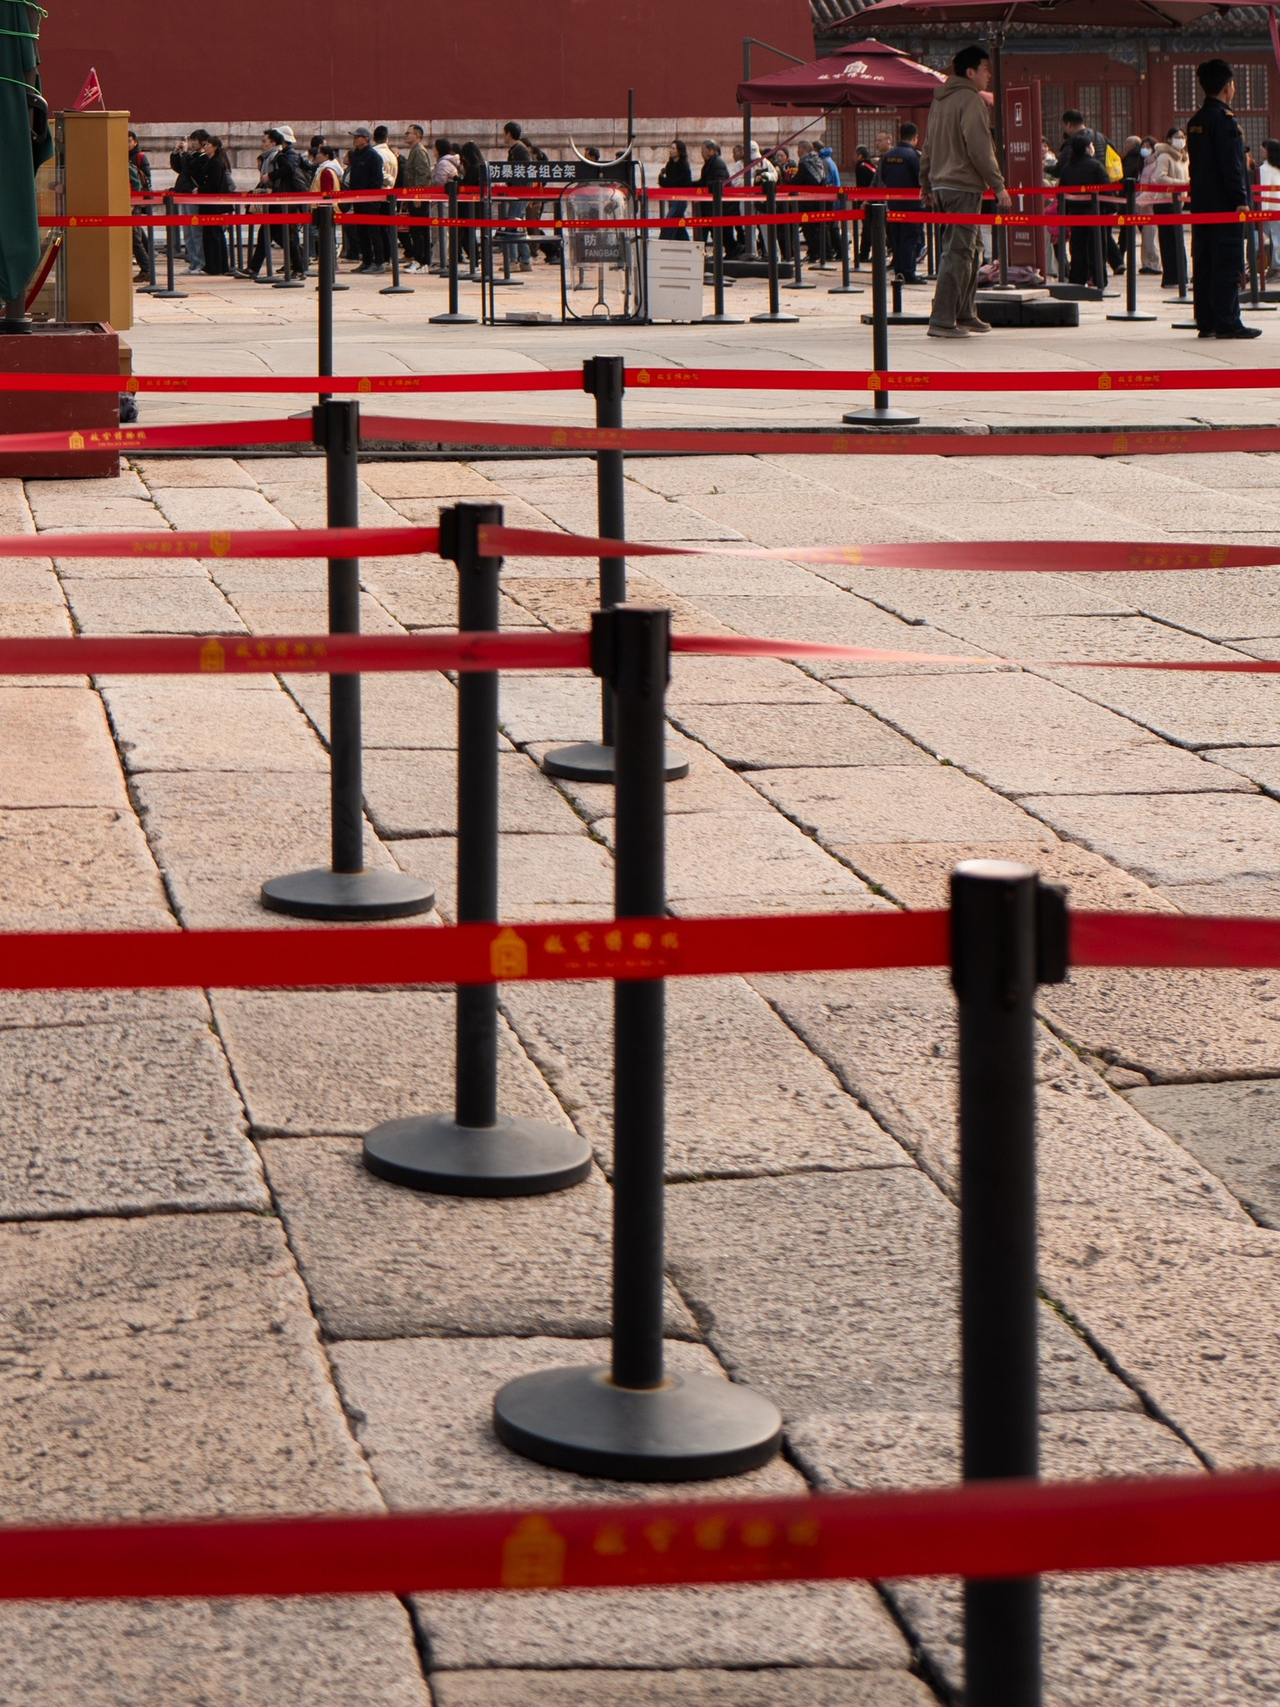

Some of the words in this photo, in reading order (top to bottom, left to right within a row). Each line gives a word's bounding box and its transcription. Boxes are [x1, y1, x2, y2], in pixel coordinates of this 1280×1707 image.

[489, 164, 576, 179] 防暴装备组合架
